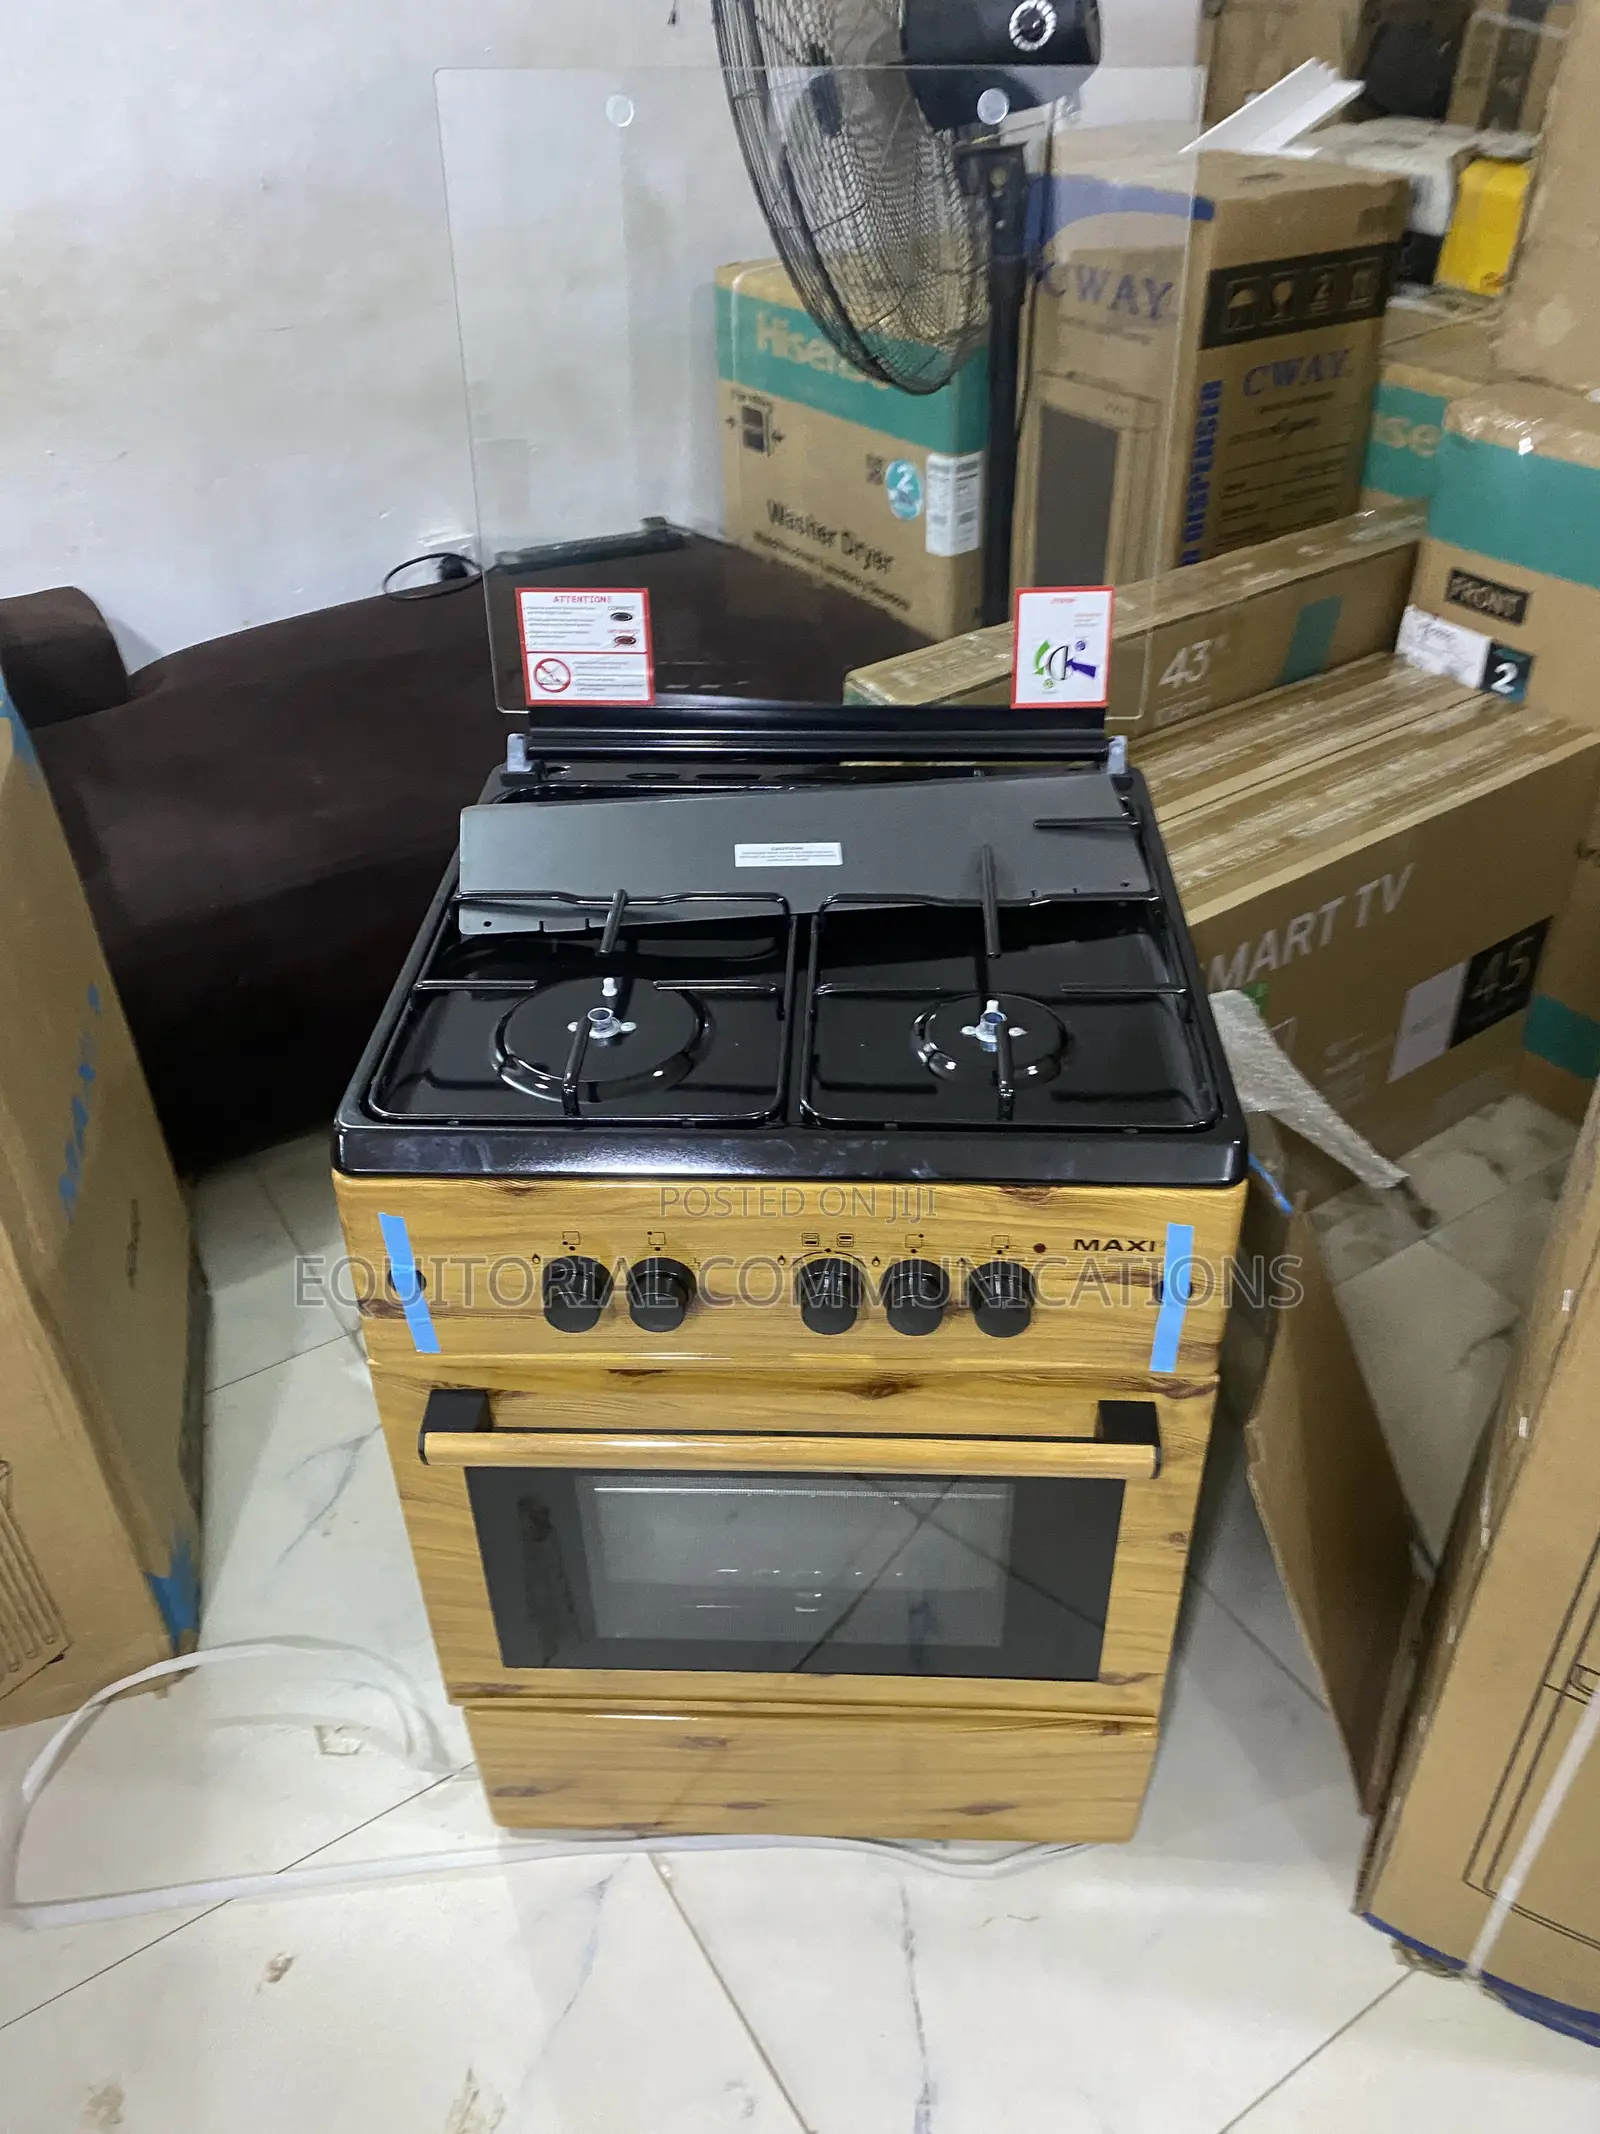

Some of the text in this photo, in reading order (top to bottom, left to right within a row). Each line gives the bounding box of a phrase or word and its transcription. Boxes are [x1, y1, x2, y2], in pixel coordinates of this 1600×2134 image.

[1243, 347, 1354, 396] CWAY
[896, 463, 916, 494] 2
[766, 500, 838, 548] Washer
[841, 529, 895, 575] Dryer
[1490, 662, 1519, 694] 2
[1354, 861, 1417, 929] TV
[1073, 1239, 1155, 1252] MAXI
